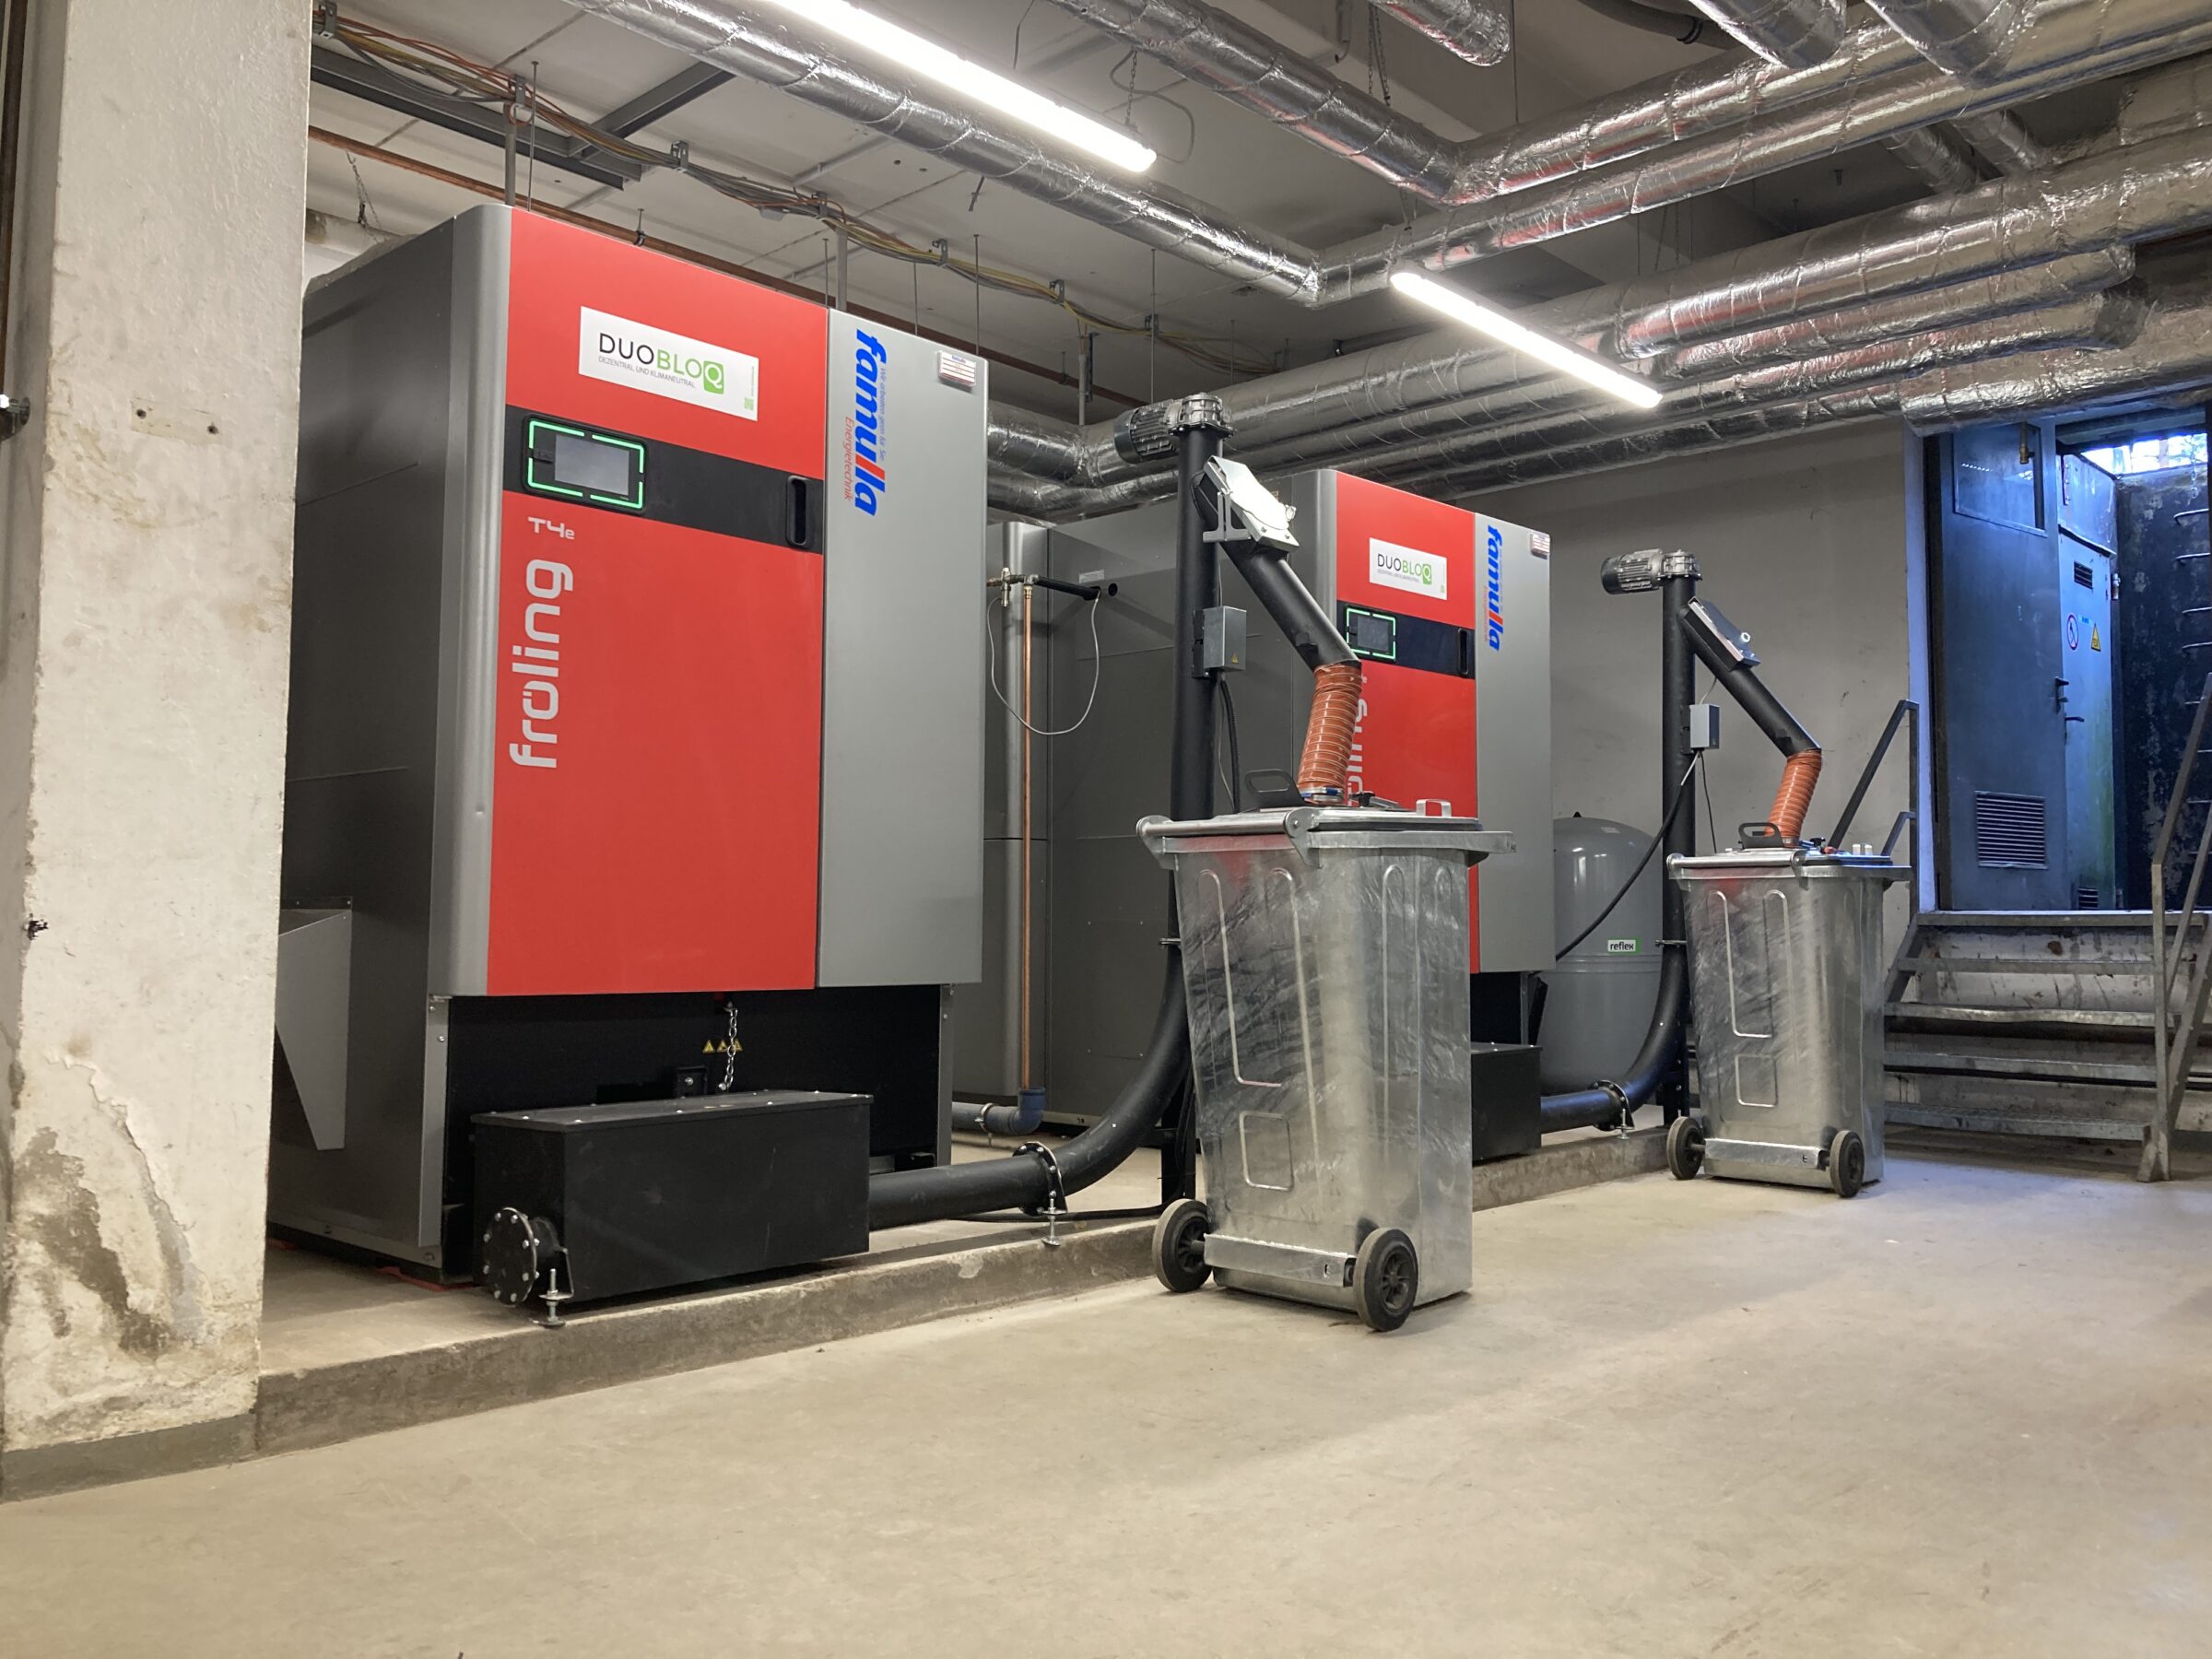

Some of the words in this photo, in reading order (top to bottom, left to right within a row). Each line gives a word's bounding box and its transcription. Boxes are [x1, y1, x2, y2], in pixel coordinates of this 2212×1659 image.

[598, 356, 635, 372] DEZENTRAL
[635, 366, 650, 376] UND
[650, 371, 696, 389] KLIMANEUTRAL
[599, 332, 724, 394] DUOBLOQ
[855, 329, 887, 516] famulla
[843, 417, 854, 501] Energietechnik
[527, 516, 575, 540] T4e
[1377, 553, 1432, 584] DUOBLOQ
[1488, 525, 1503, 652] famulla
[509, 559, 573, 769] fröling
[1609, 941, 1634, 951] reflex
